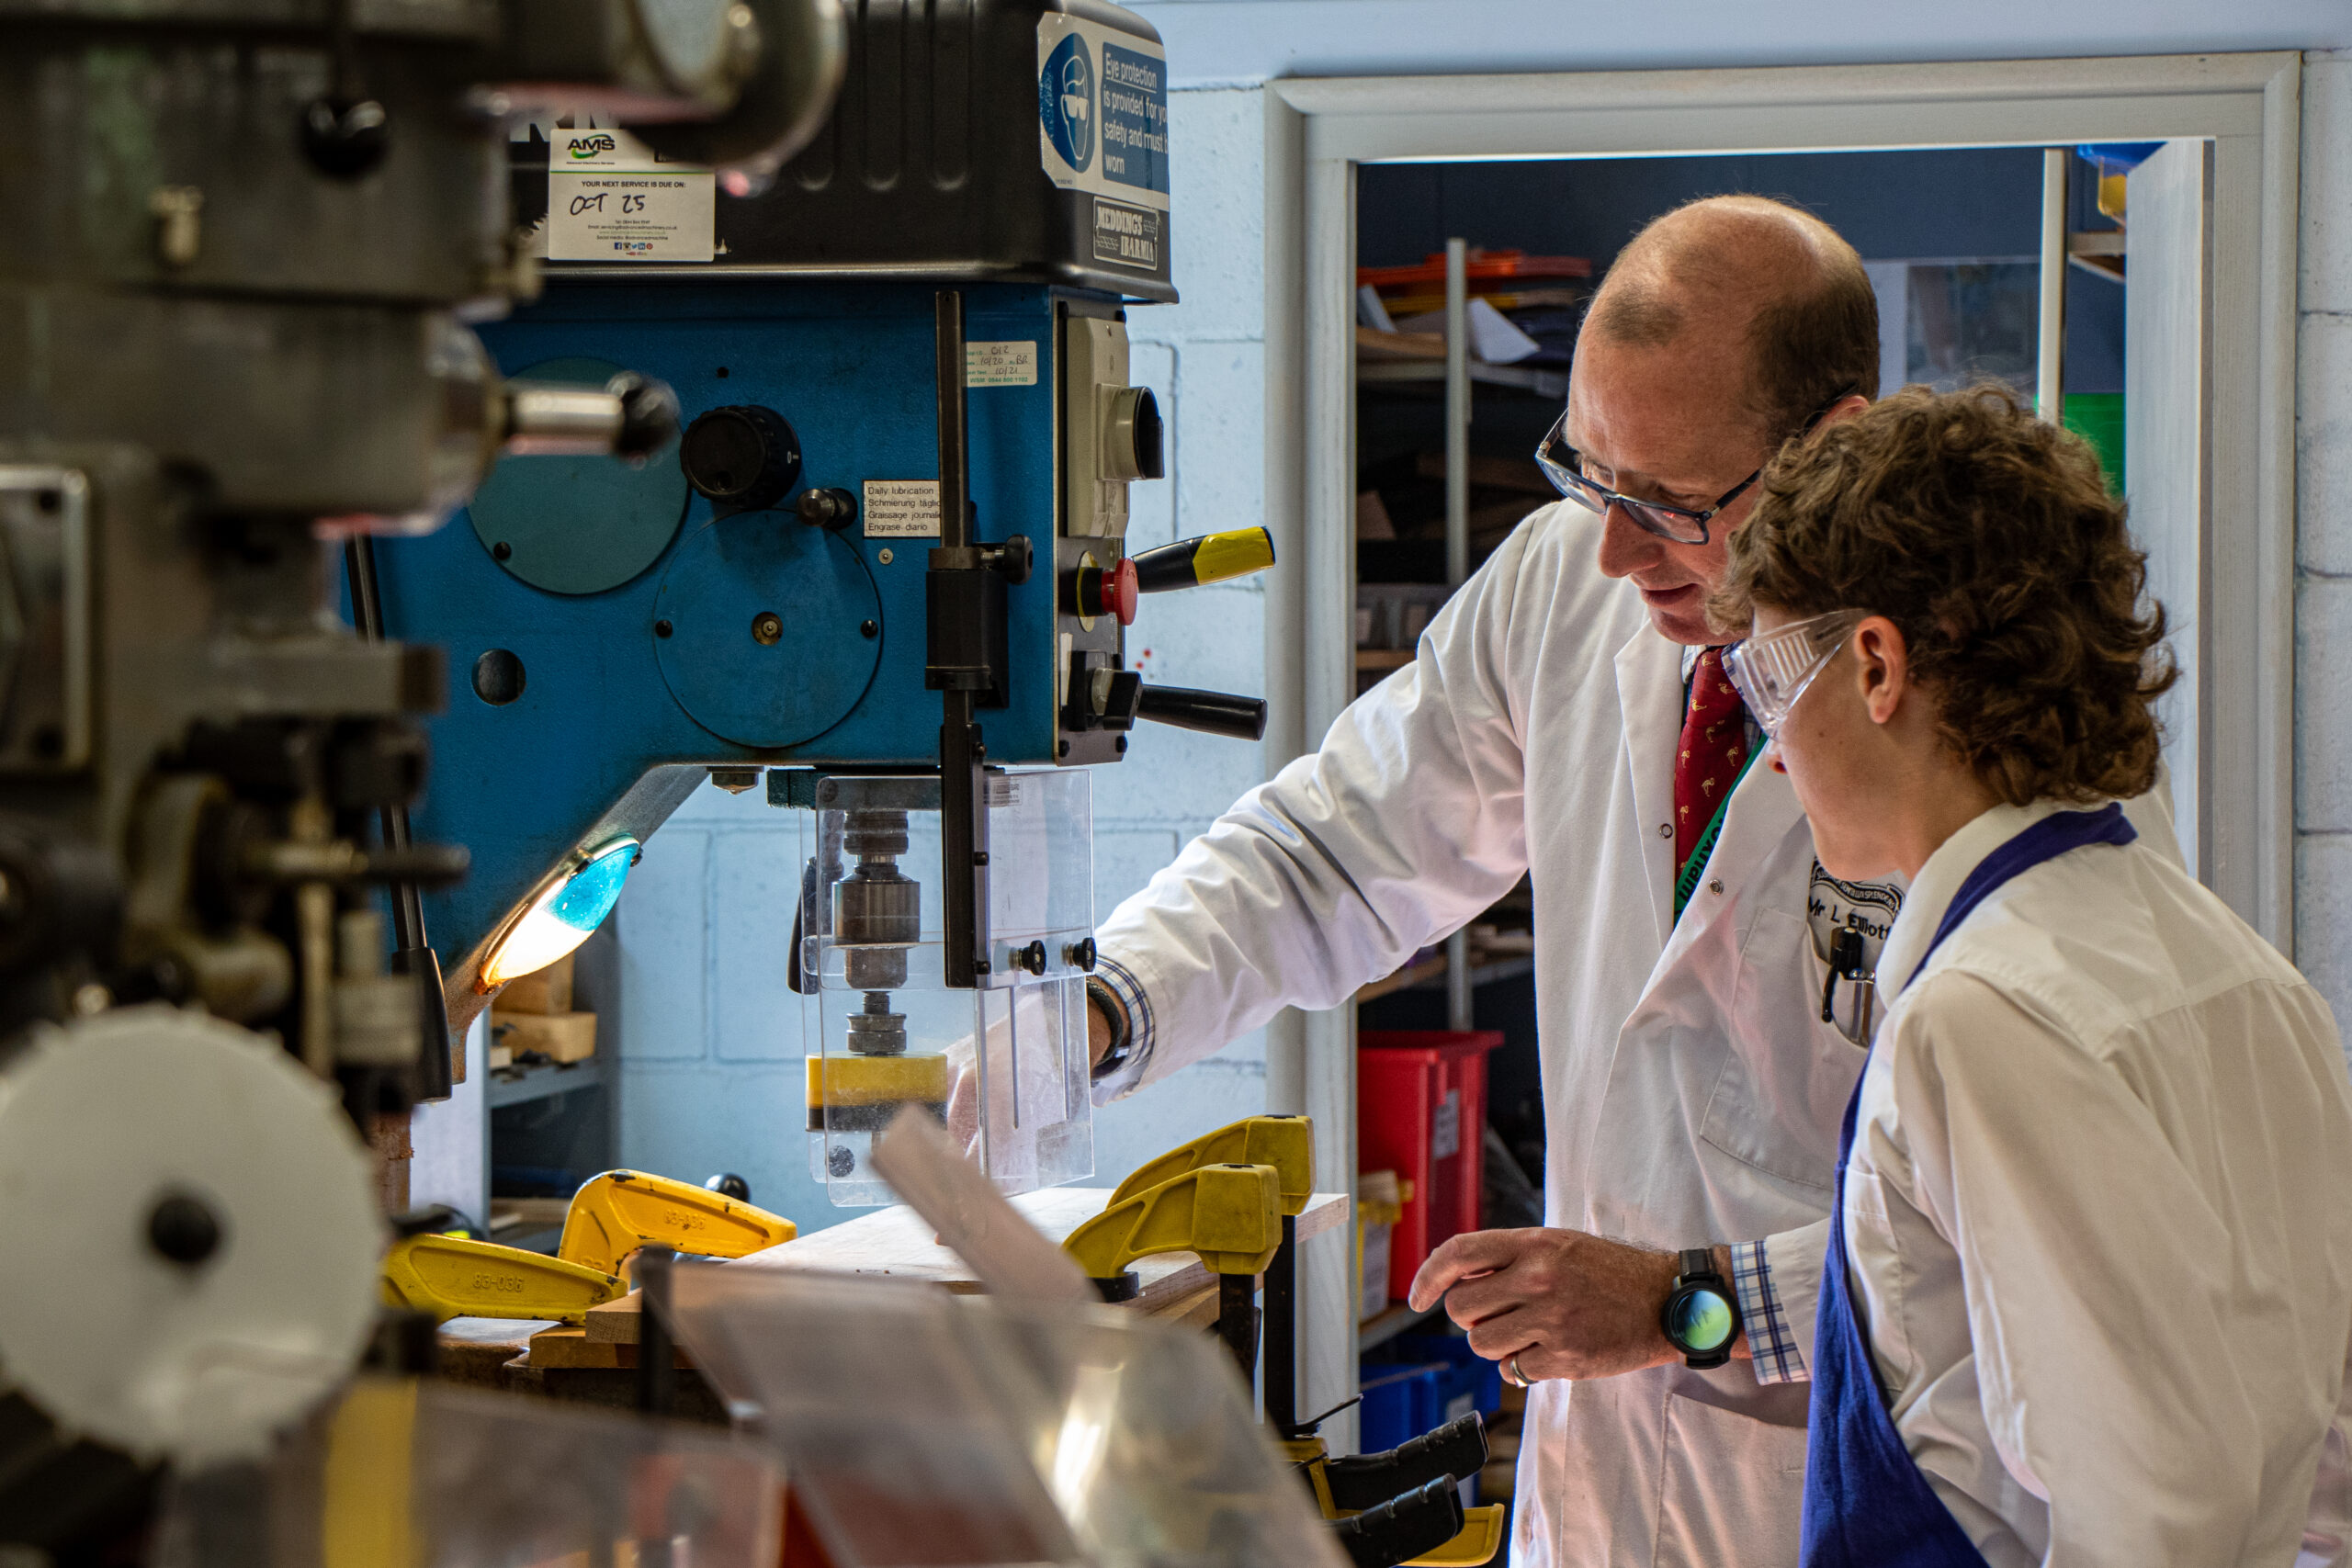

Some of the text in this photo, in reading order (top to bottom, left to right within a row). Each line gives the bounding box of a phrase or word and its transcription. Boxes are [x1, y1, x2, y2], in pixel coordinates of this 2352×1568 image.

[1105, 52, 1158, 89] Eye protection
[1103, 84, 1111, 108] is
[1112, 92, 1144, 117] provided
[1146, 96, 1157, 120] for
[567, 139, 616, 151] AMS
[1104, 118, 1127, 149] safety
[1128, 127, 1143, 148] and
[1144, 132, 1163, 153] must
[1105, 153, 1125, 175] worn
[570, 193, 646, 216] OCT 25
[1097, 206, 1143, 235] MEDDINGS
[1121, 235, 1154, 262] IBARMIA
[868, 486, 934, 495] Daily lubrication
[868, 499, 941, 508] Schmierung täglic
[868, 511, 941, 521] Graissage journali
[868, 523, 928, 532] Engrase diario
[1807, 897, 1826, 917] Mr
[1830, 904, 1841, 924] L
